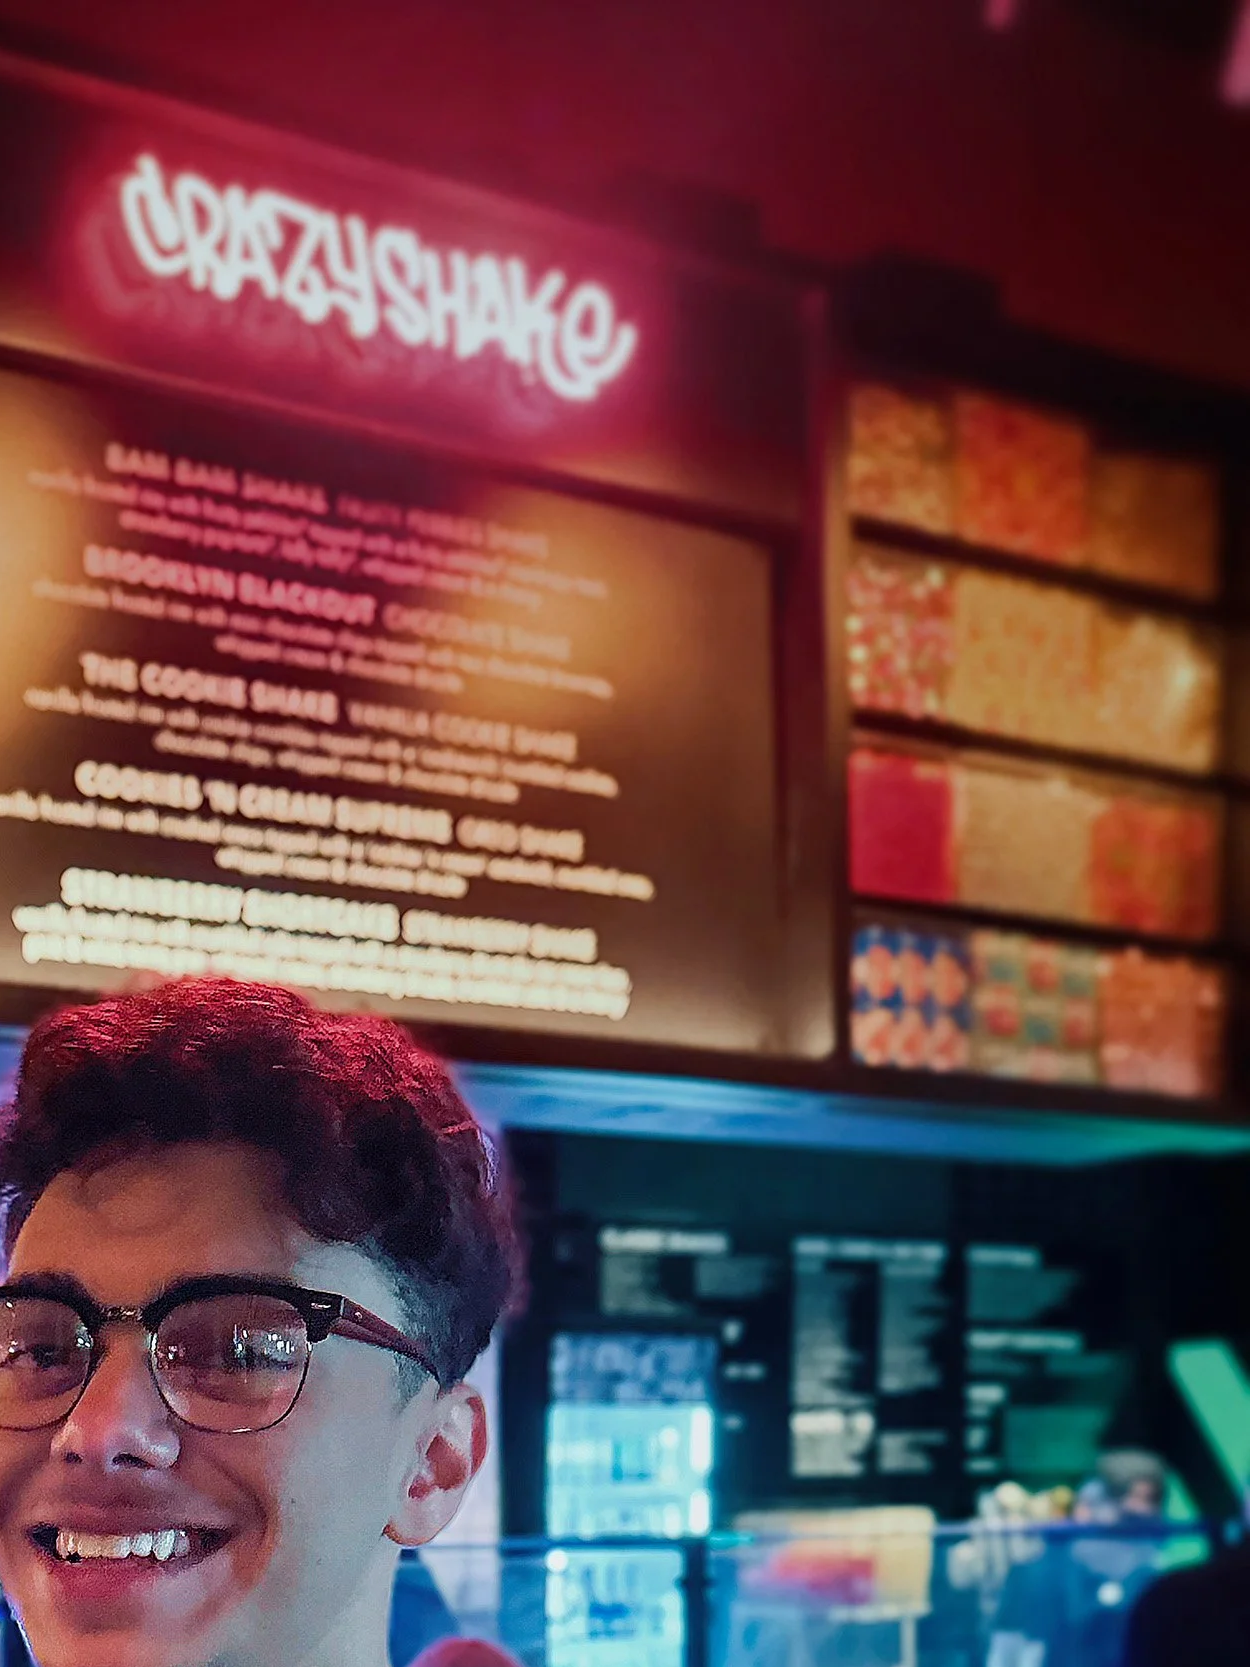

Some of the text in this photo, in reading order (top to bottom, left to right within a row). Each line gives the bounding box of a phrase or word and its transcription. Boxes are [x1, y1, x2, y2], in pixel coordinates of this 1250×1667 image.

[83, 543, 236, 601] BROOKLYN
[238, 572, 376, 626] BLACKOUT
[78, 651, 138, 693] THE
[140, 662, 247, 709] COOKIE
